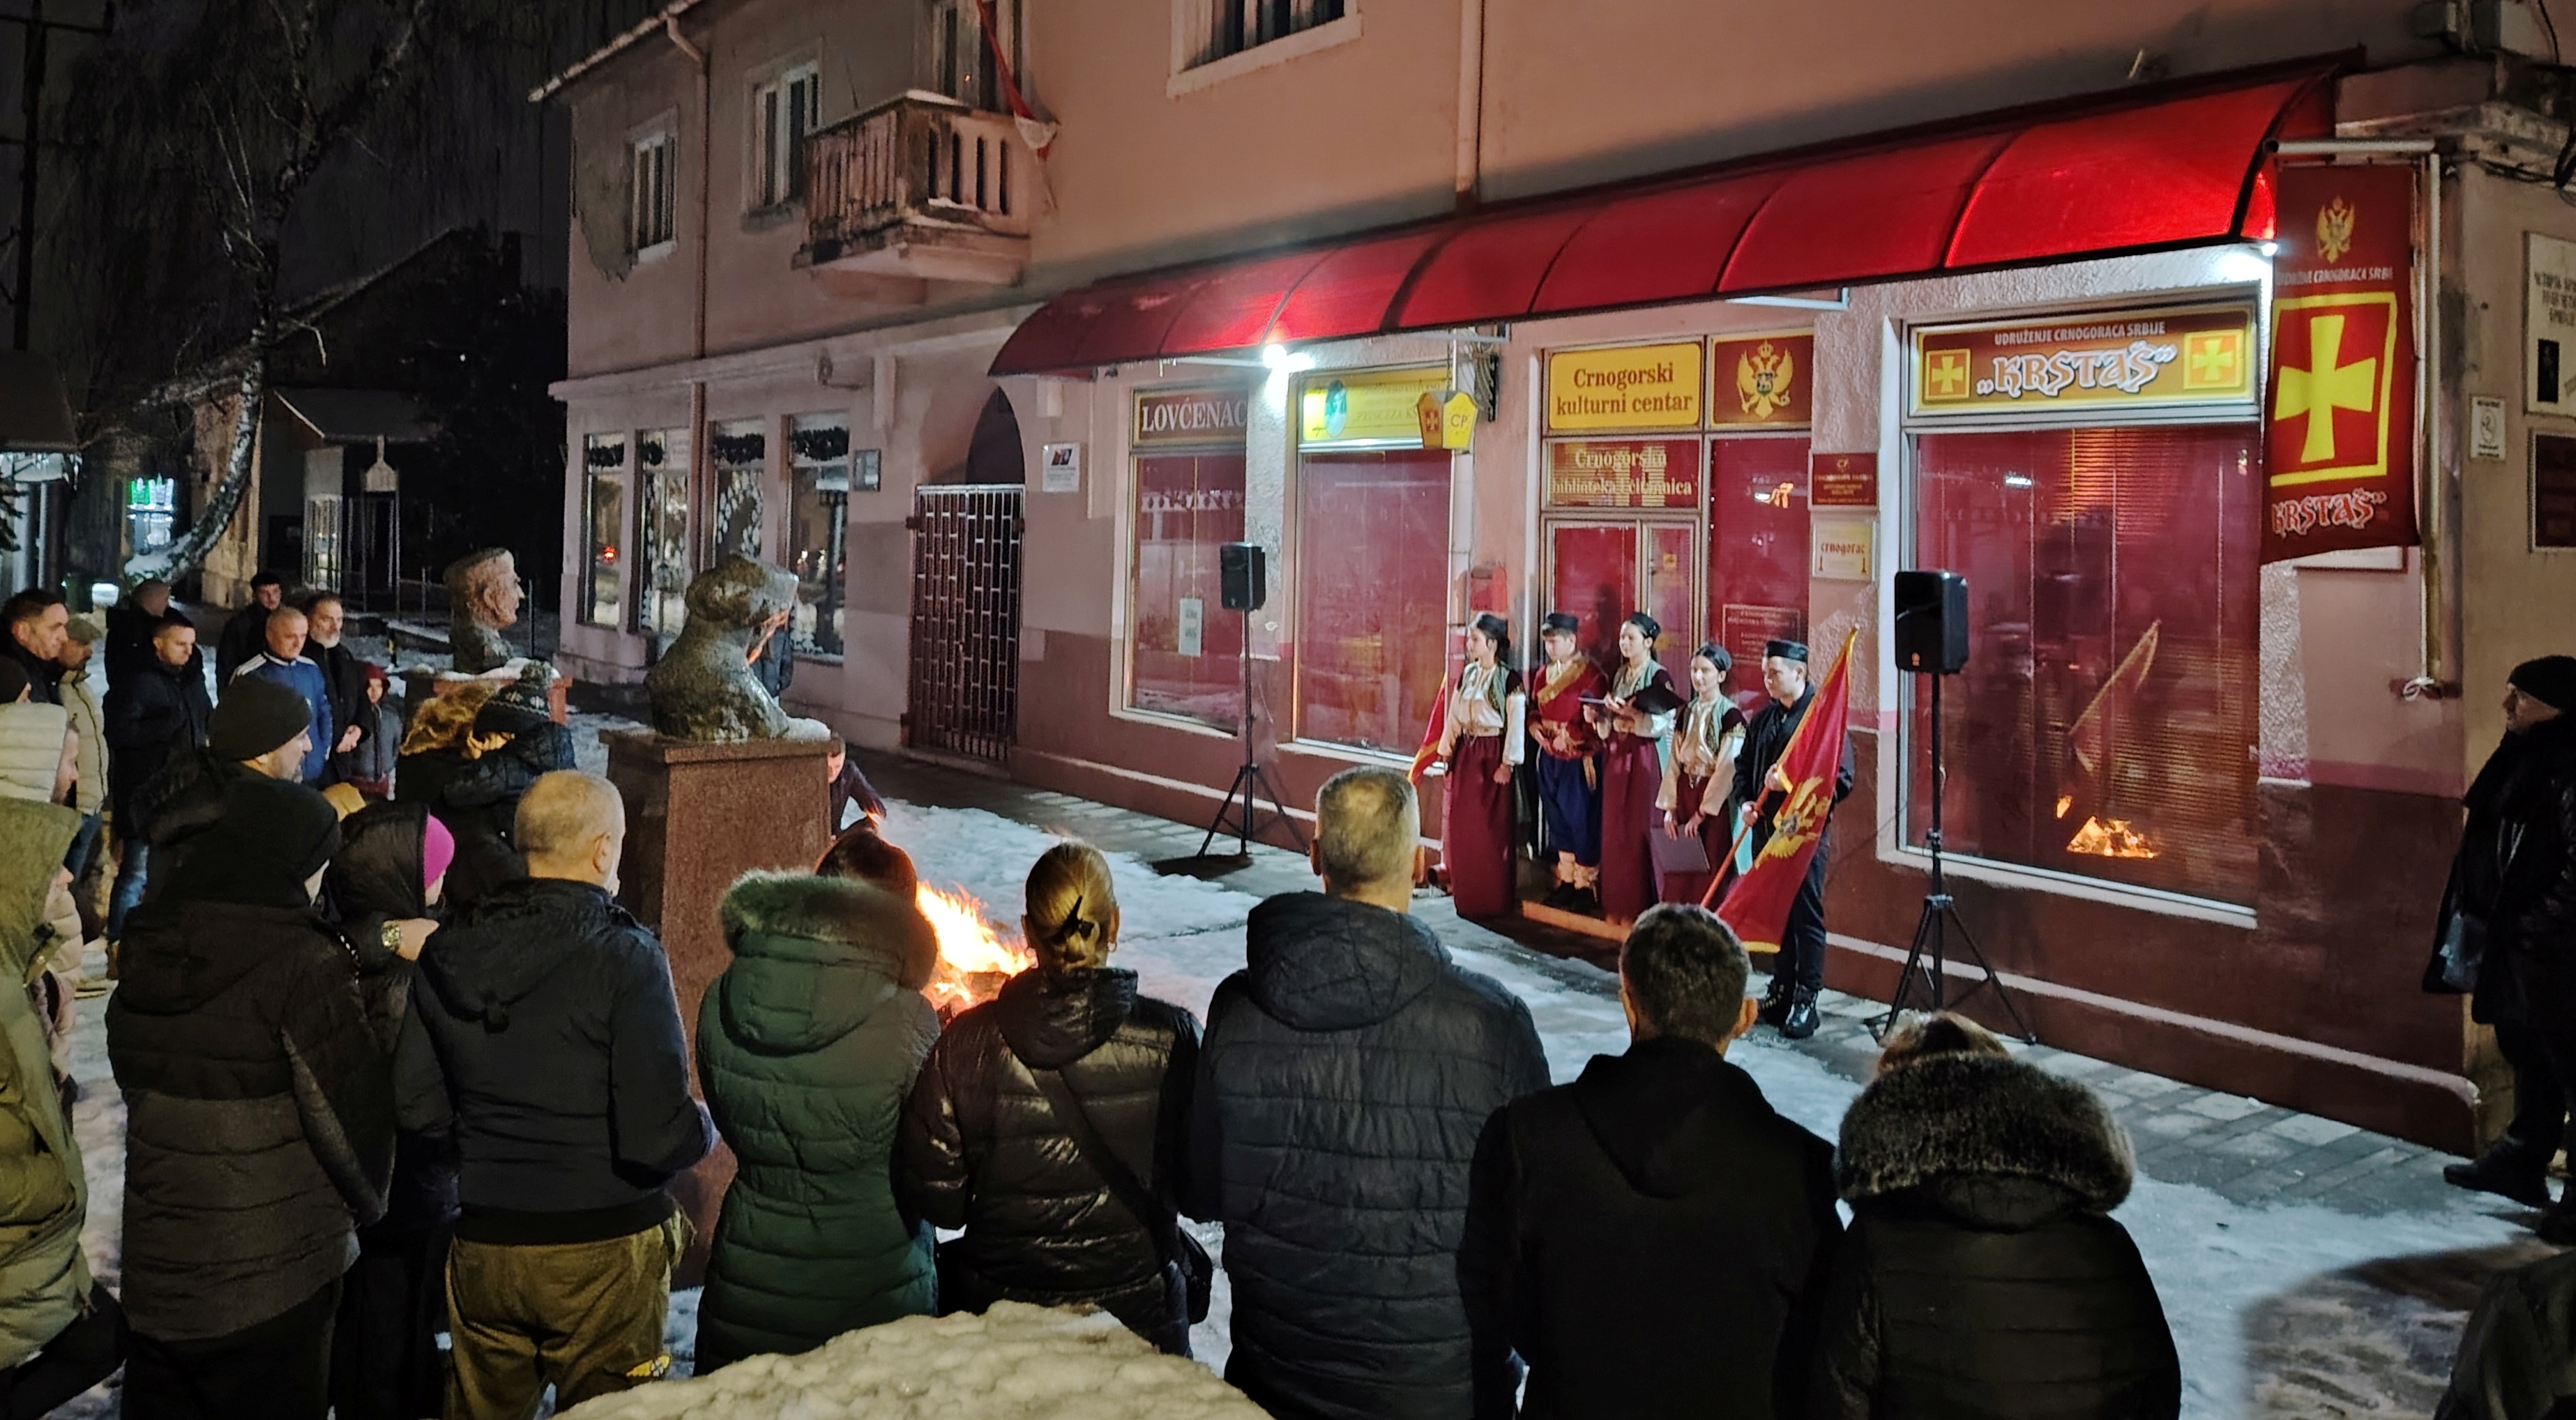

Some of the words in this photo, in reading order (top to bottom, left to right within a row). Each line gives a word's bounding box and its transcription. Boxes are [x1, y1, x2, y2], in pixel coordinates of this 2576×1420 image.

[1994, 328, 2052, 346] UDRUŽENJE
[2054, 326, 2126, 342] CRNOGORACA
[2127, 321, 2165, 336] SRBIJE
[1573, 362, 1674, 391] Crnogorski
[1142, 396, 1247, 432] LOVĆENAC
[1556, 393, 1627, 416] kulturni
[1632, 391, 1693, 413] centar
[1820, 541, 1865, 556] crnogorac
